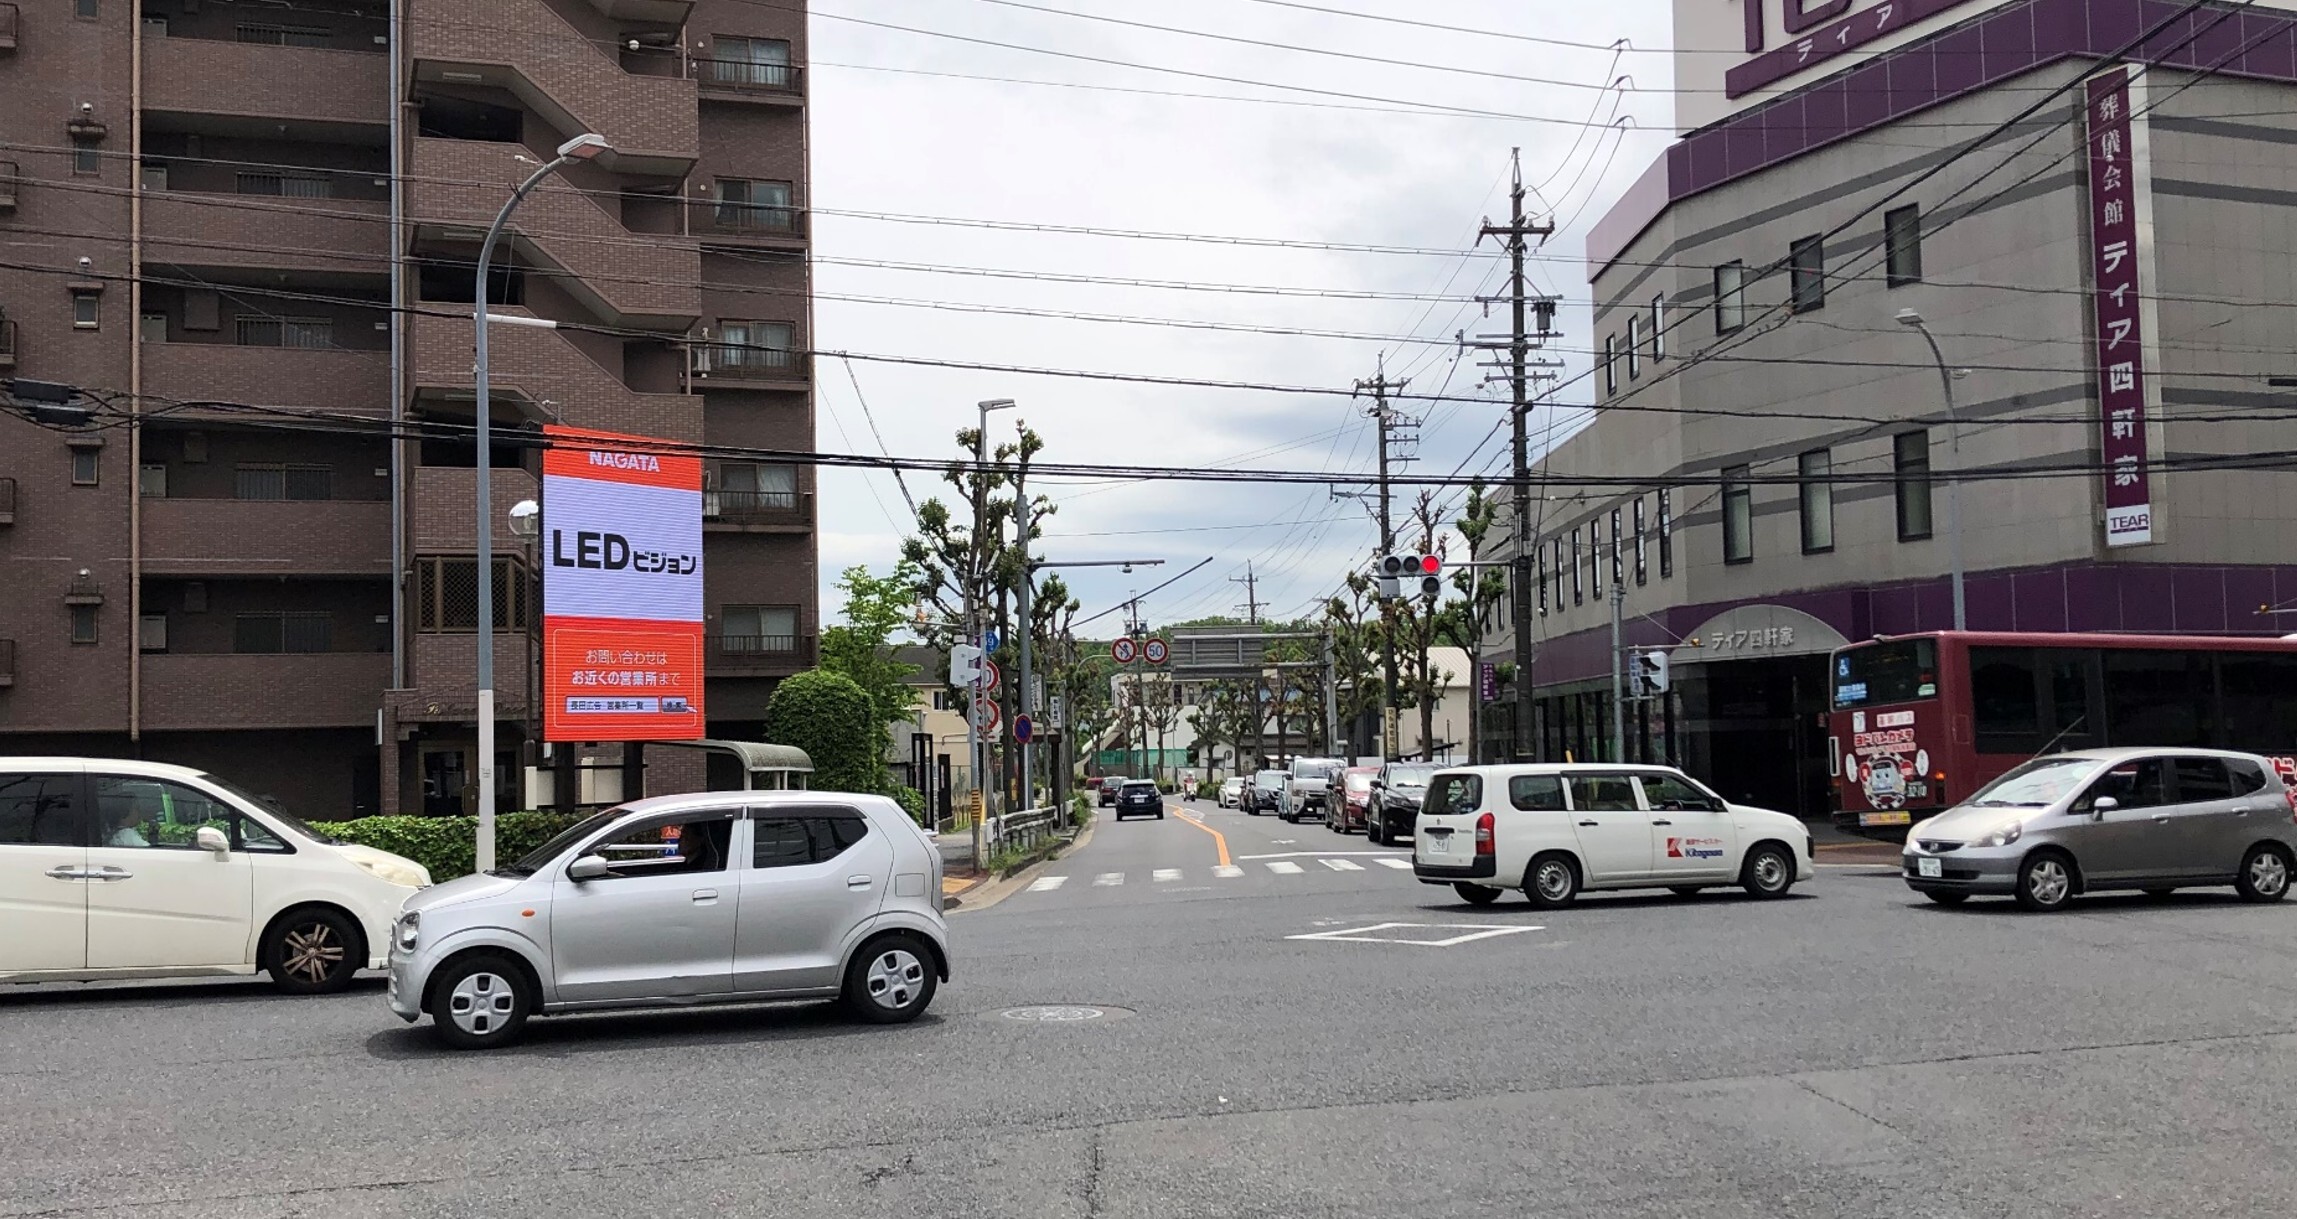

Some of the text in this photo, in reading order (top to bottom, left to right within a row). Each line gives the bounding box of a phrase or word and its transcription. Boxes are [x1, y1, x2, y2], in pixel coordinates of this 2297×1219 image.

[1797, 4, 1893, 63] ティア
[588, 451, 660, 472] NAGATA
[2110, 513, 2149, 528] TEAR
[586, 650, 668, 665] お問い合わせは
[1148, 644, 1163, 657] 50
[572, 671, 681, 686] お近くの営業所まで
